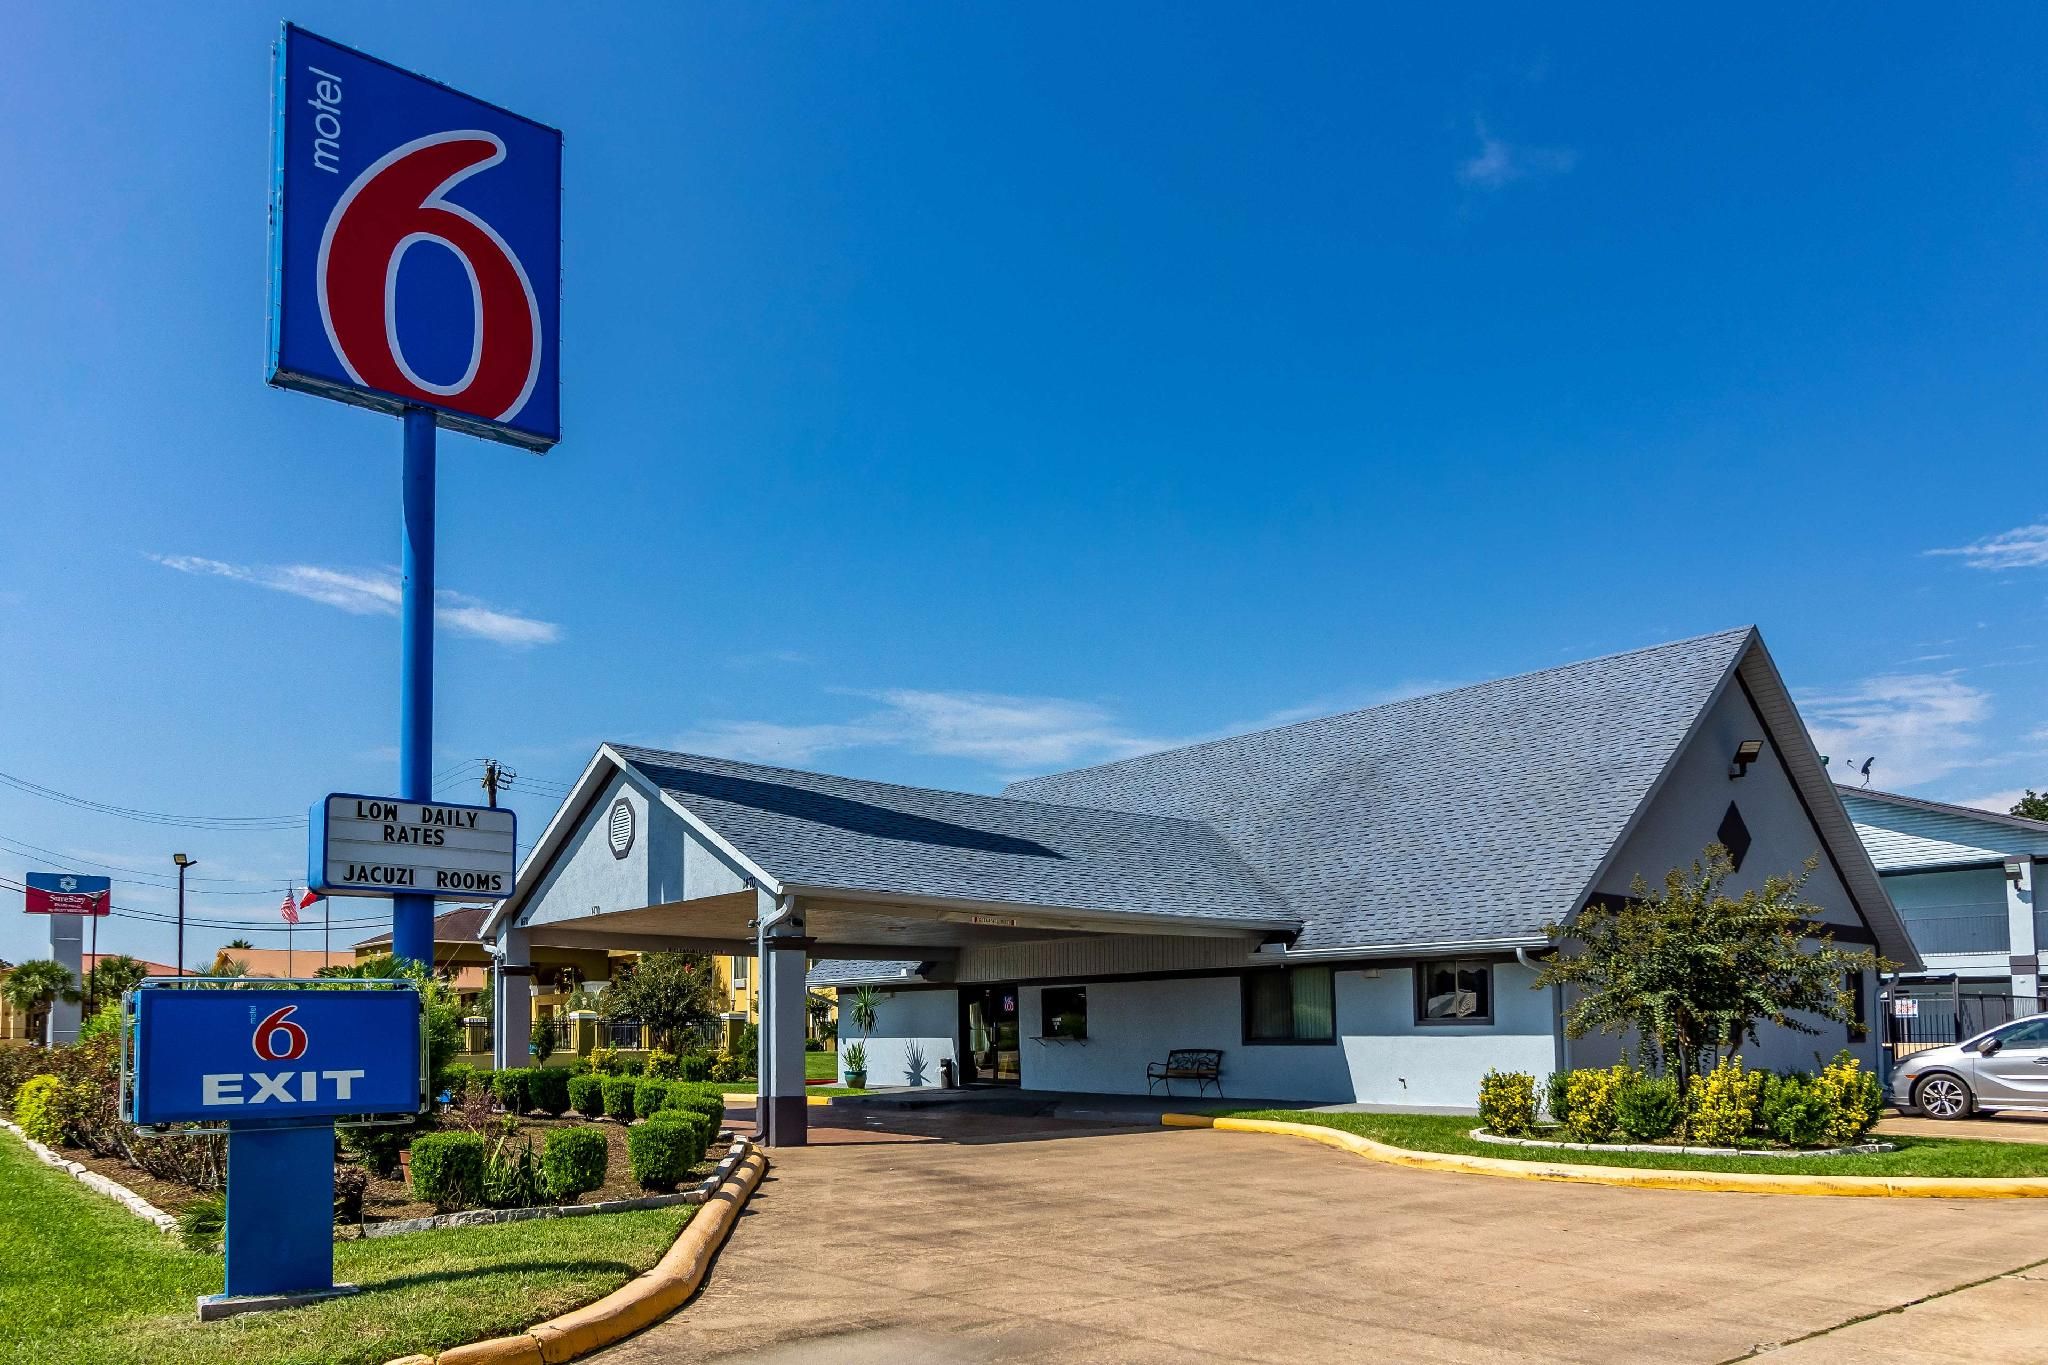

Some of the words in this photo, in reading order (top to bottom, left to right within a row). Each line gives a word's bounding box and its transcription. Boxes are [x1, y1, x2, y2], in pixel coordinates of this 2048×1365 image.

[308, 65, 343, 174] motel
[316, 129, 543, 424] 6
[357, 800, 398, 821] LOW
[421, 806, 479, 828] DAILY
[383, 824, 445, 845] RATES
[343, 864, 415, 886] JACUZI
[436, 871, 502, 891] ROOMS
[49, 894, 86, 904] SureStay
[252, 1004, 309, 1061] 6
[202, 1069, 365, 1106] EXIT
